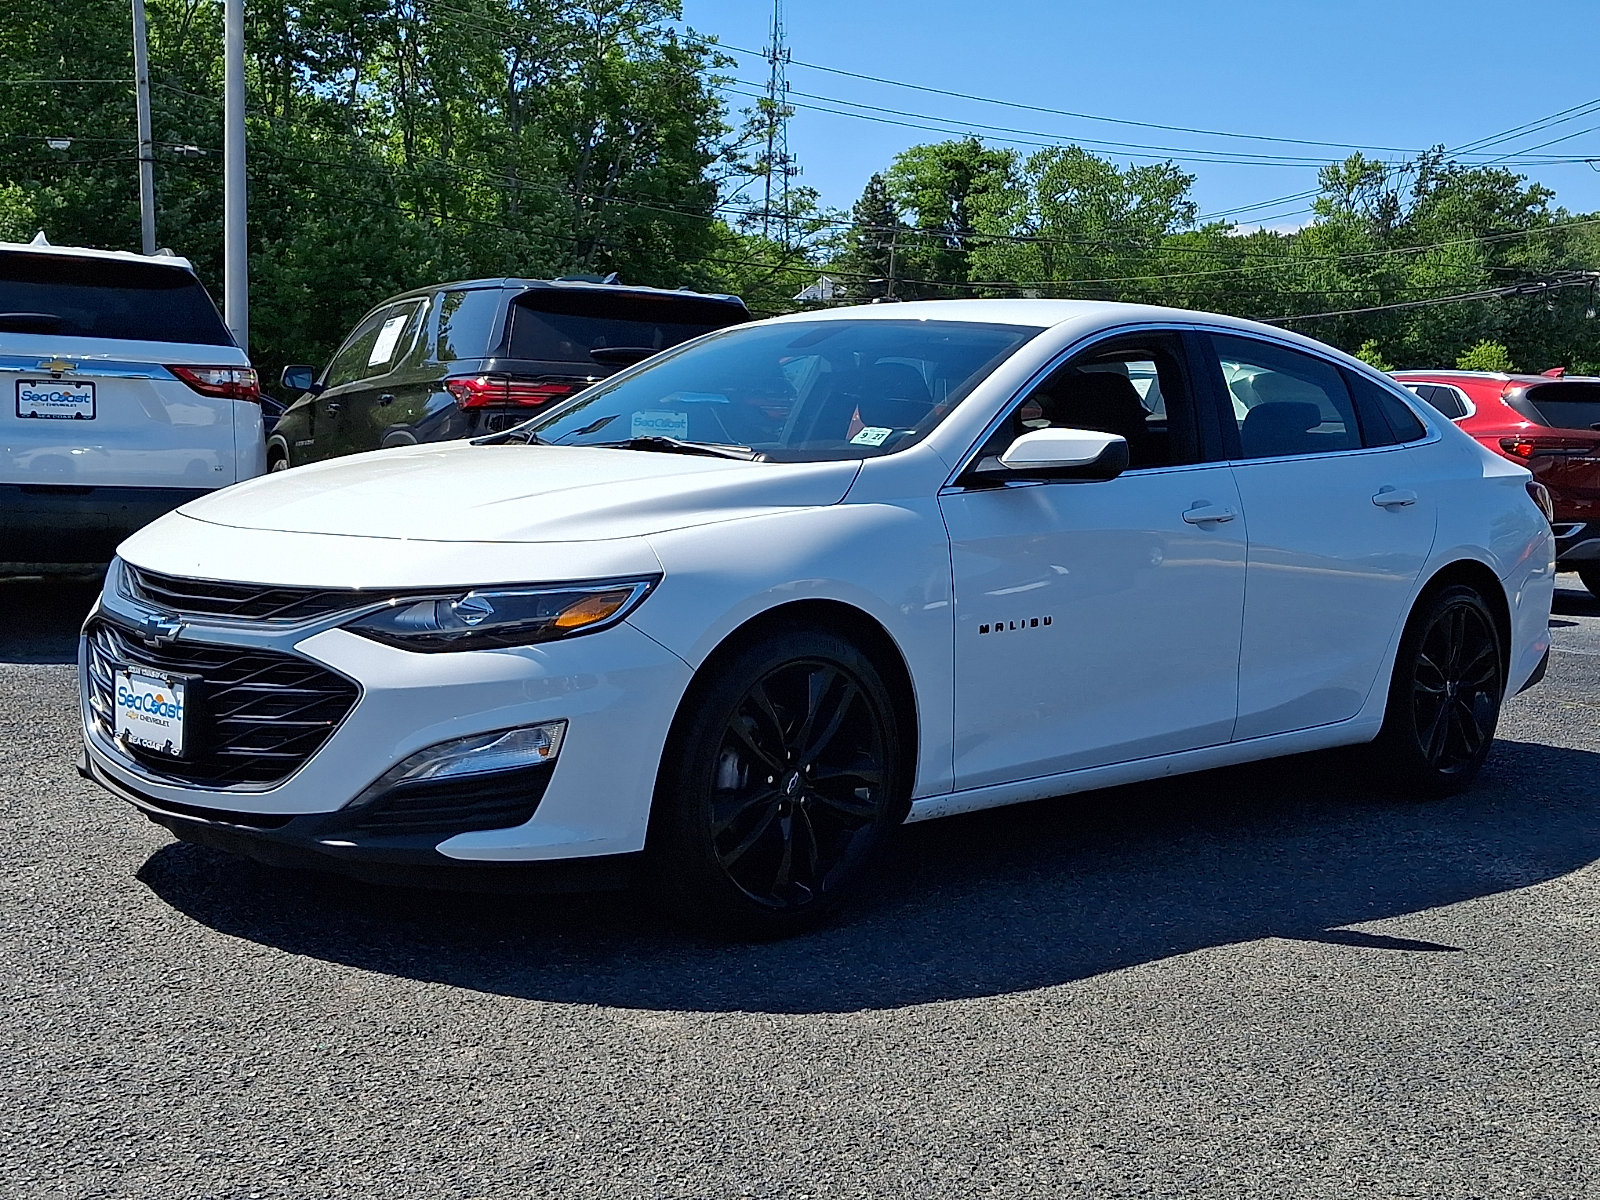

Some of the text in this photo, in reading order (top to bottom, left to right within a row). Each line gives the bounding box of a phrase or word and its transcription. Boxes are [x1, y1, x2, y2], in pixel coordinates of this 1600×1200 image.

[979, 615, 1052, 635] MALIBU
[139, 715, 169, 727] CHEVROLET
[128, 736, 164, 752] SEA COAST
